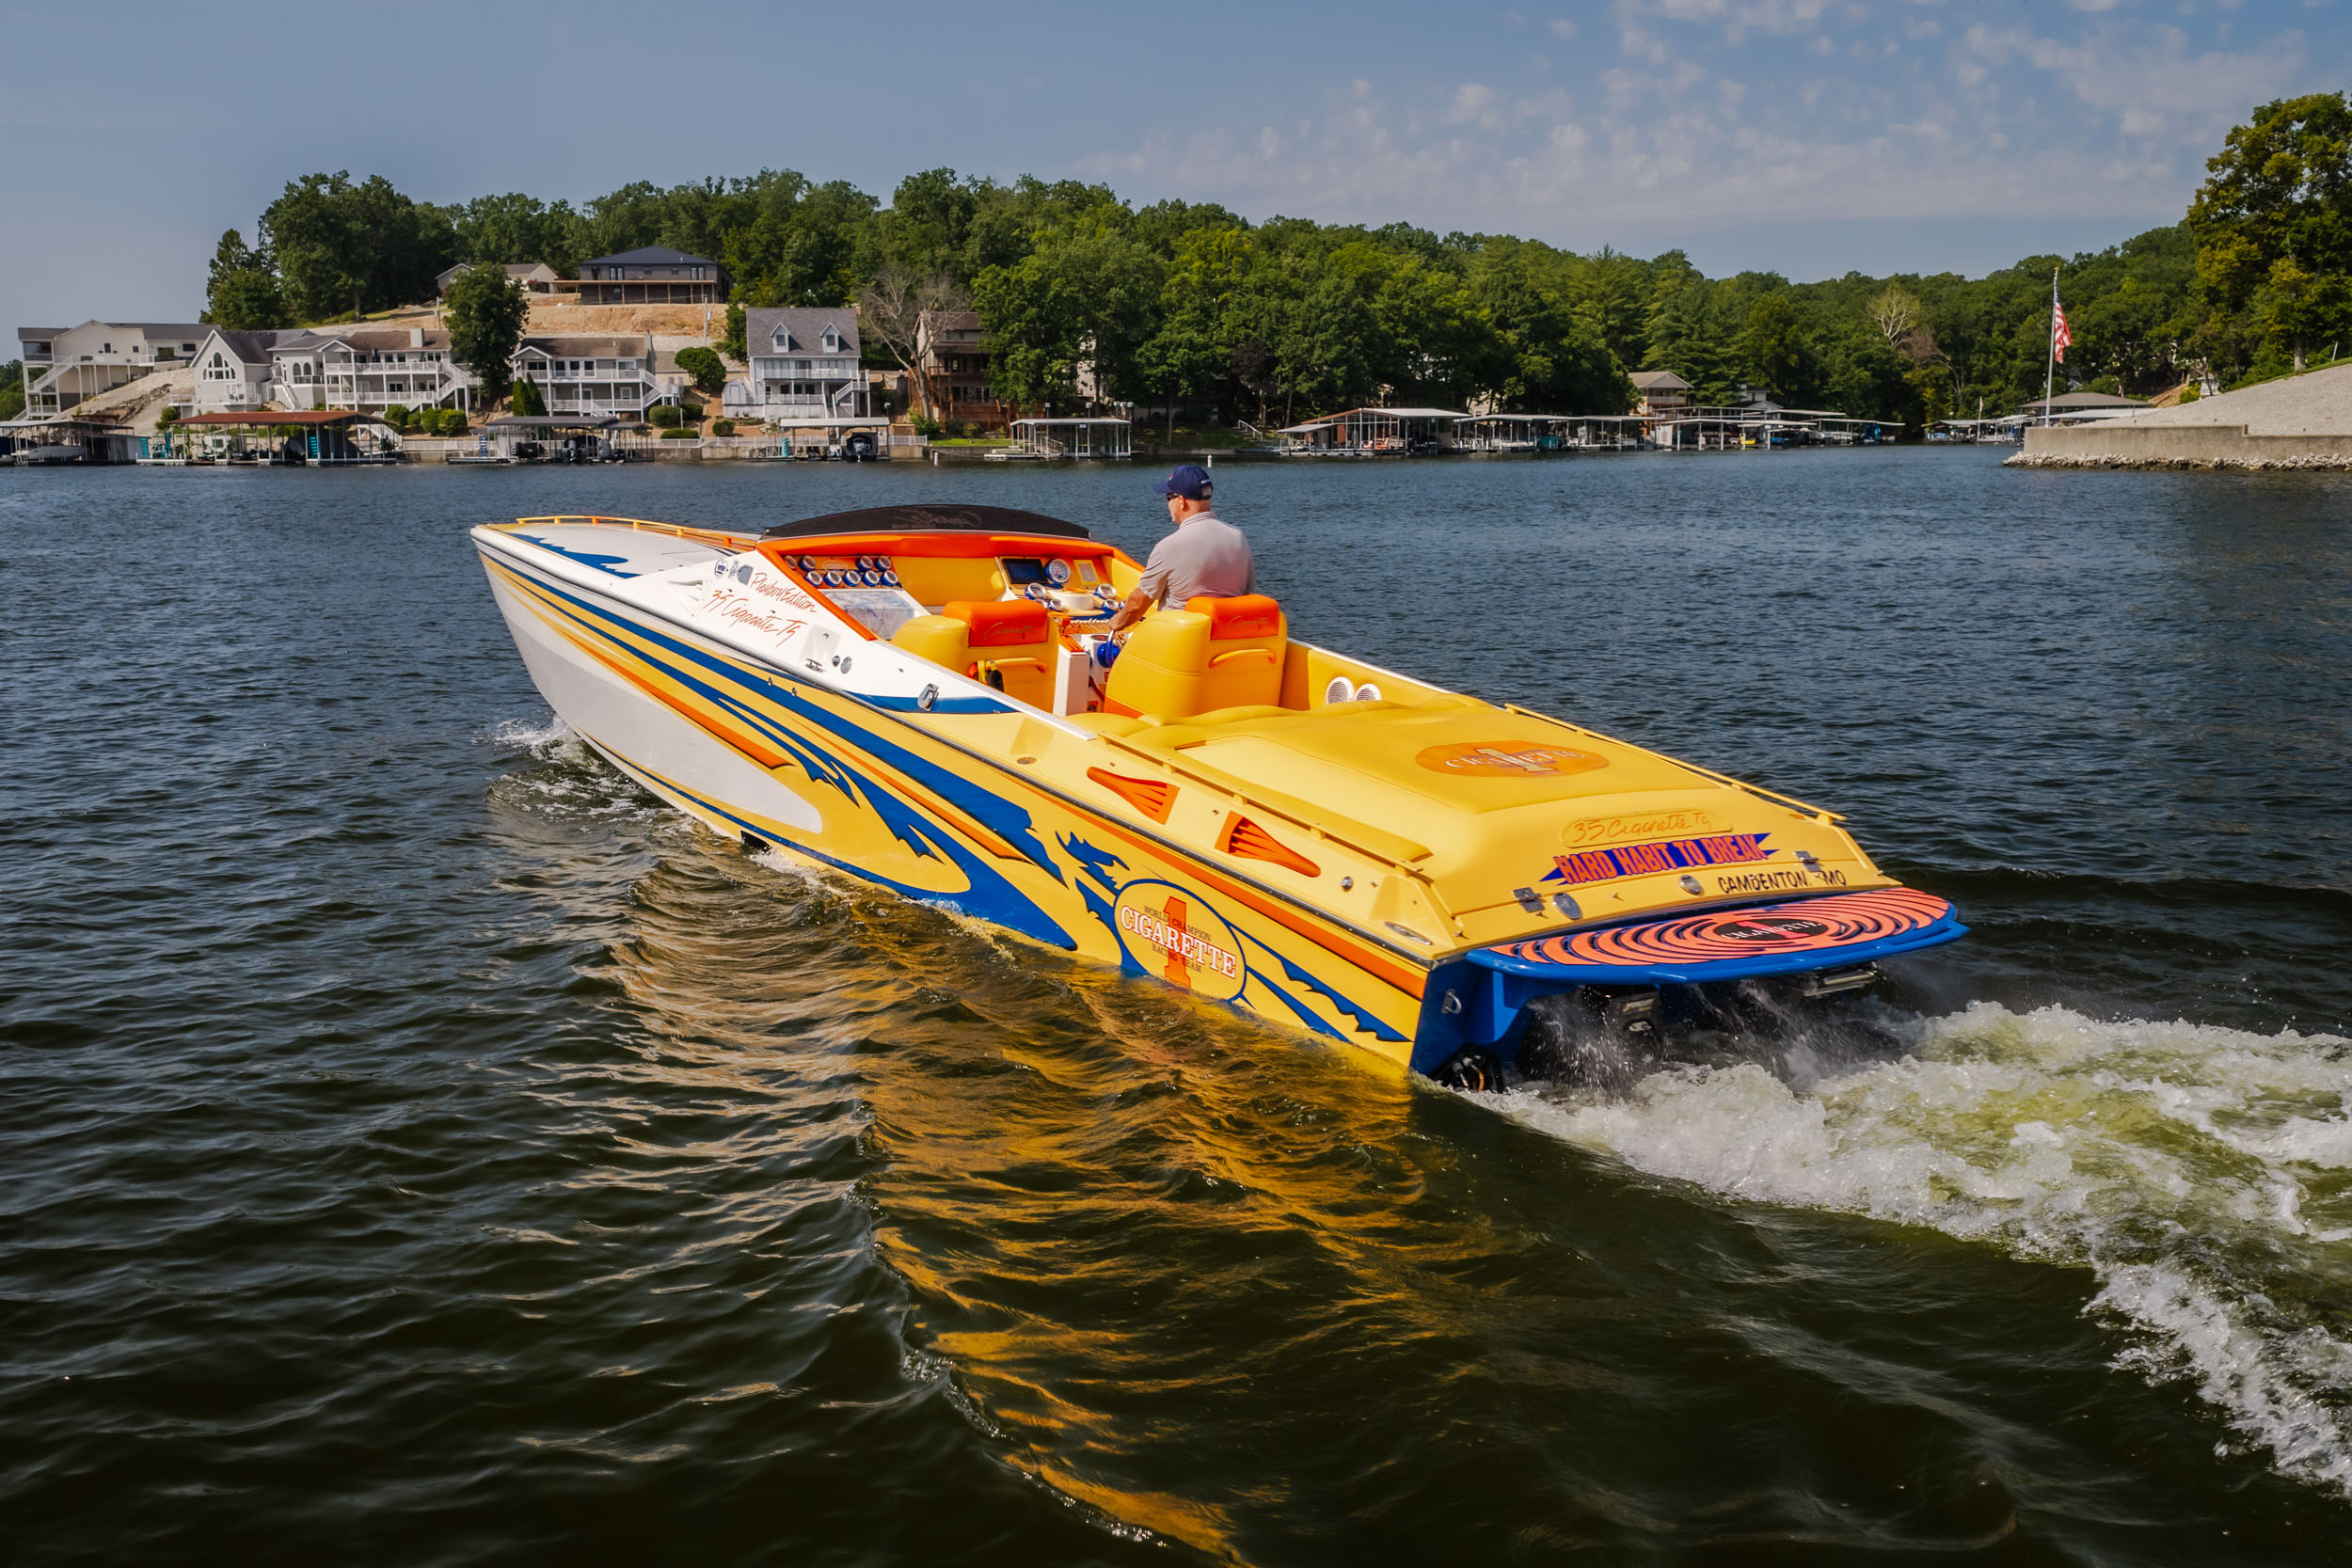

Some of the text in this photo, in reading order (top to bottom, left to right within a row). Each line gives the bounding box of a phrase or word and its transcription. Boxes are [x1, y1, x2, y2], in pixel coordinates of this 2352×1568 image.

[701, 590, 735, 613] 35
[1572, 819, 1604, 843] 35
[1553, 833, 1770, 885] HARD HABIT TO BREAK
[1821, 870, 1847, 886] MO
[1143, 905, 1168, 923] WORLD
[1120, 905, 1236, 979] CIGARETTE
